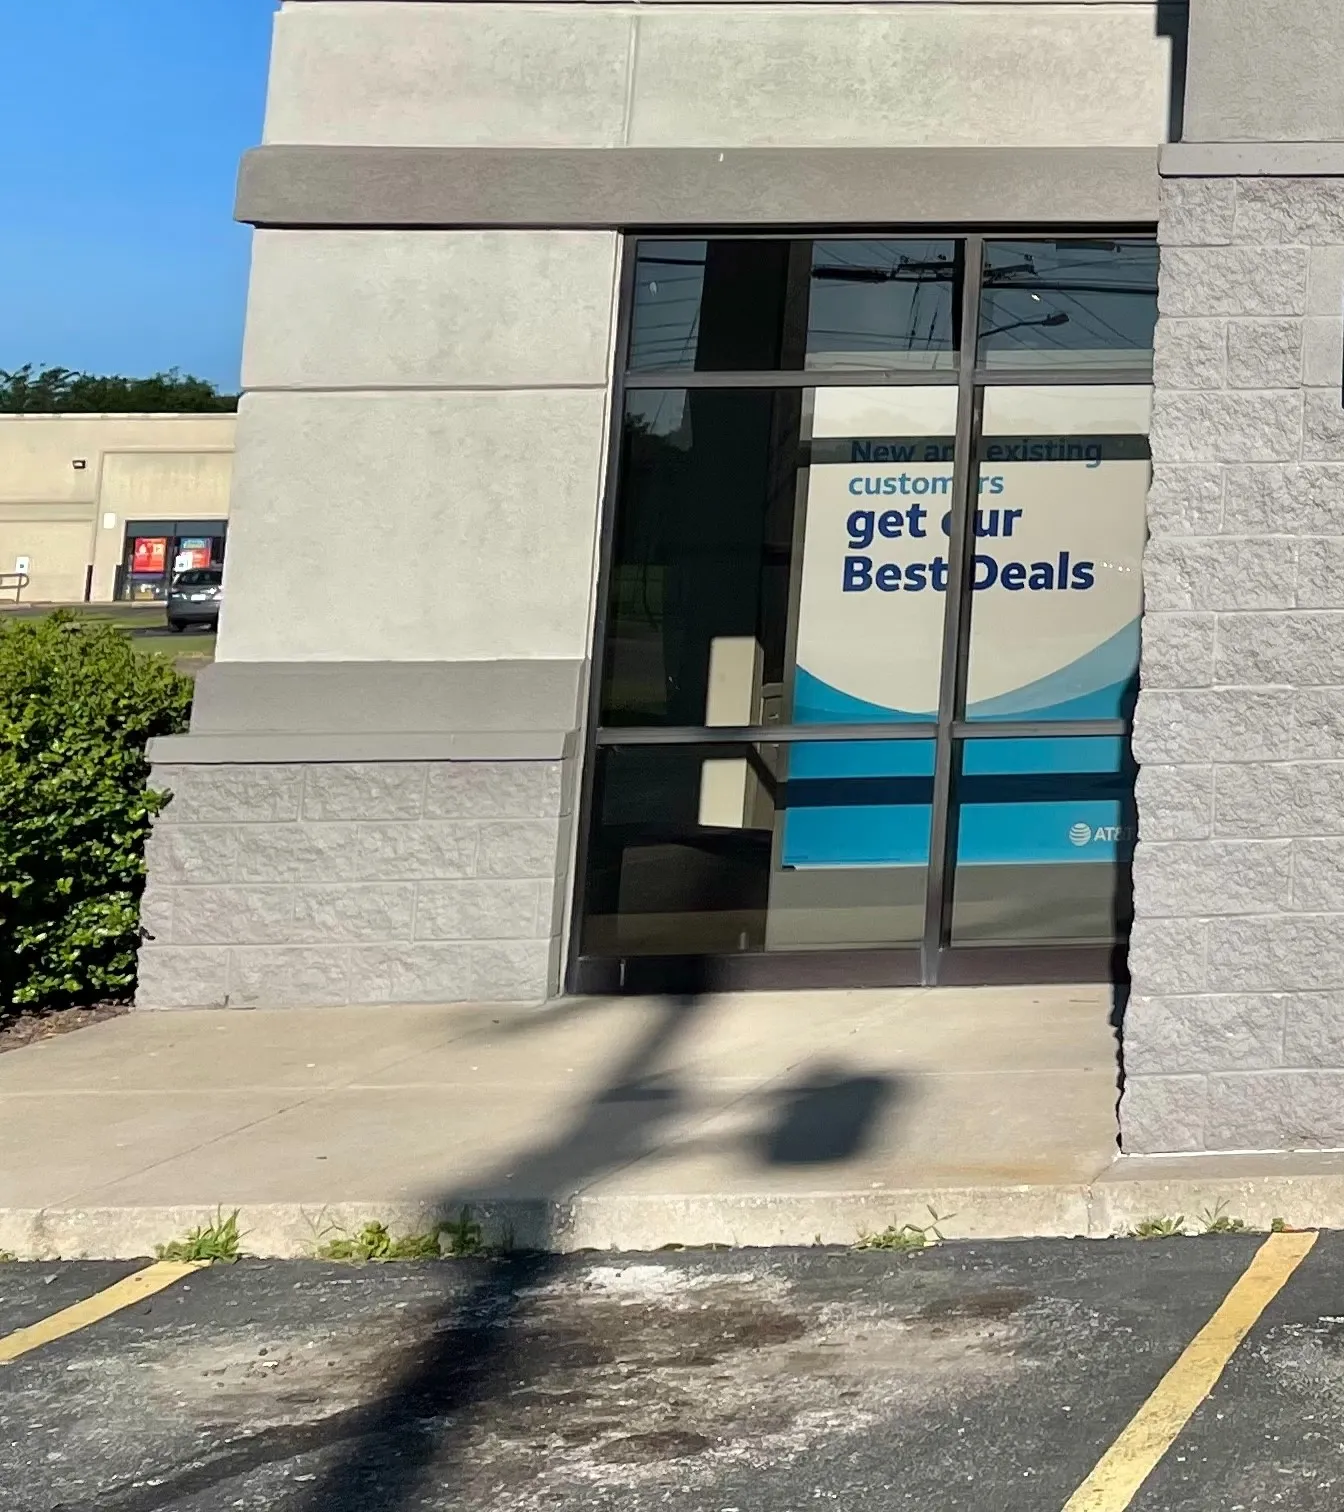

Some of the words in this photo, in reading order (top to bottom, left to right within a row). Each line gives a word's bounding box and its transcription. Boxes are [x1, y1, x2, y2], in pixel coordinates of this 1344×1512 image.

[851, 440, 915, 463] New
[986, 439, 1102, 468] existing
[848, 473, 1004, 496] customrs
[846, 503, 928, 550] get
[842, 555, 949, 593] Best
[969, 551, 1095, 592] Deals
